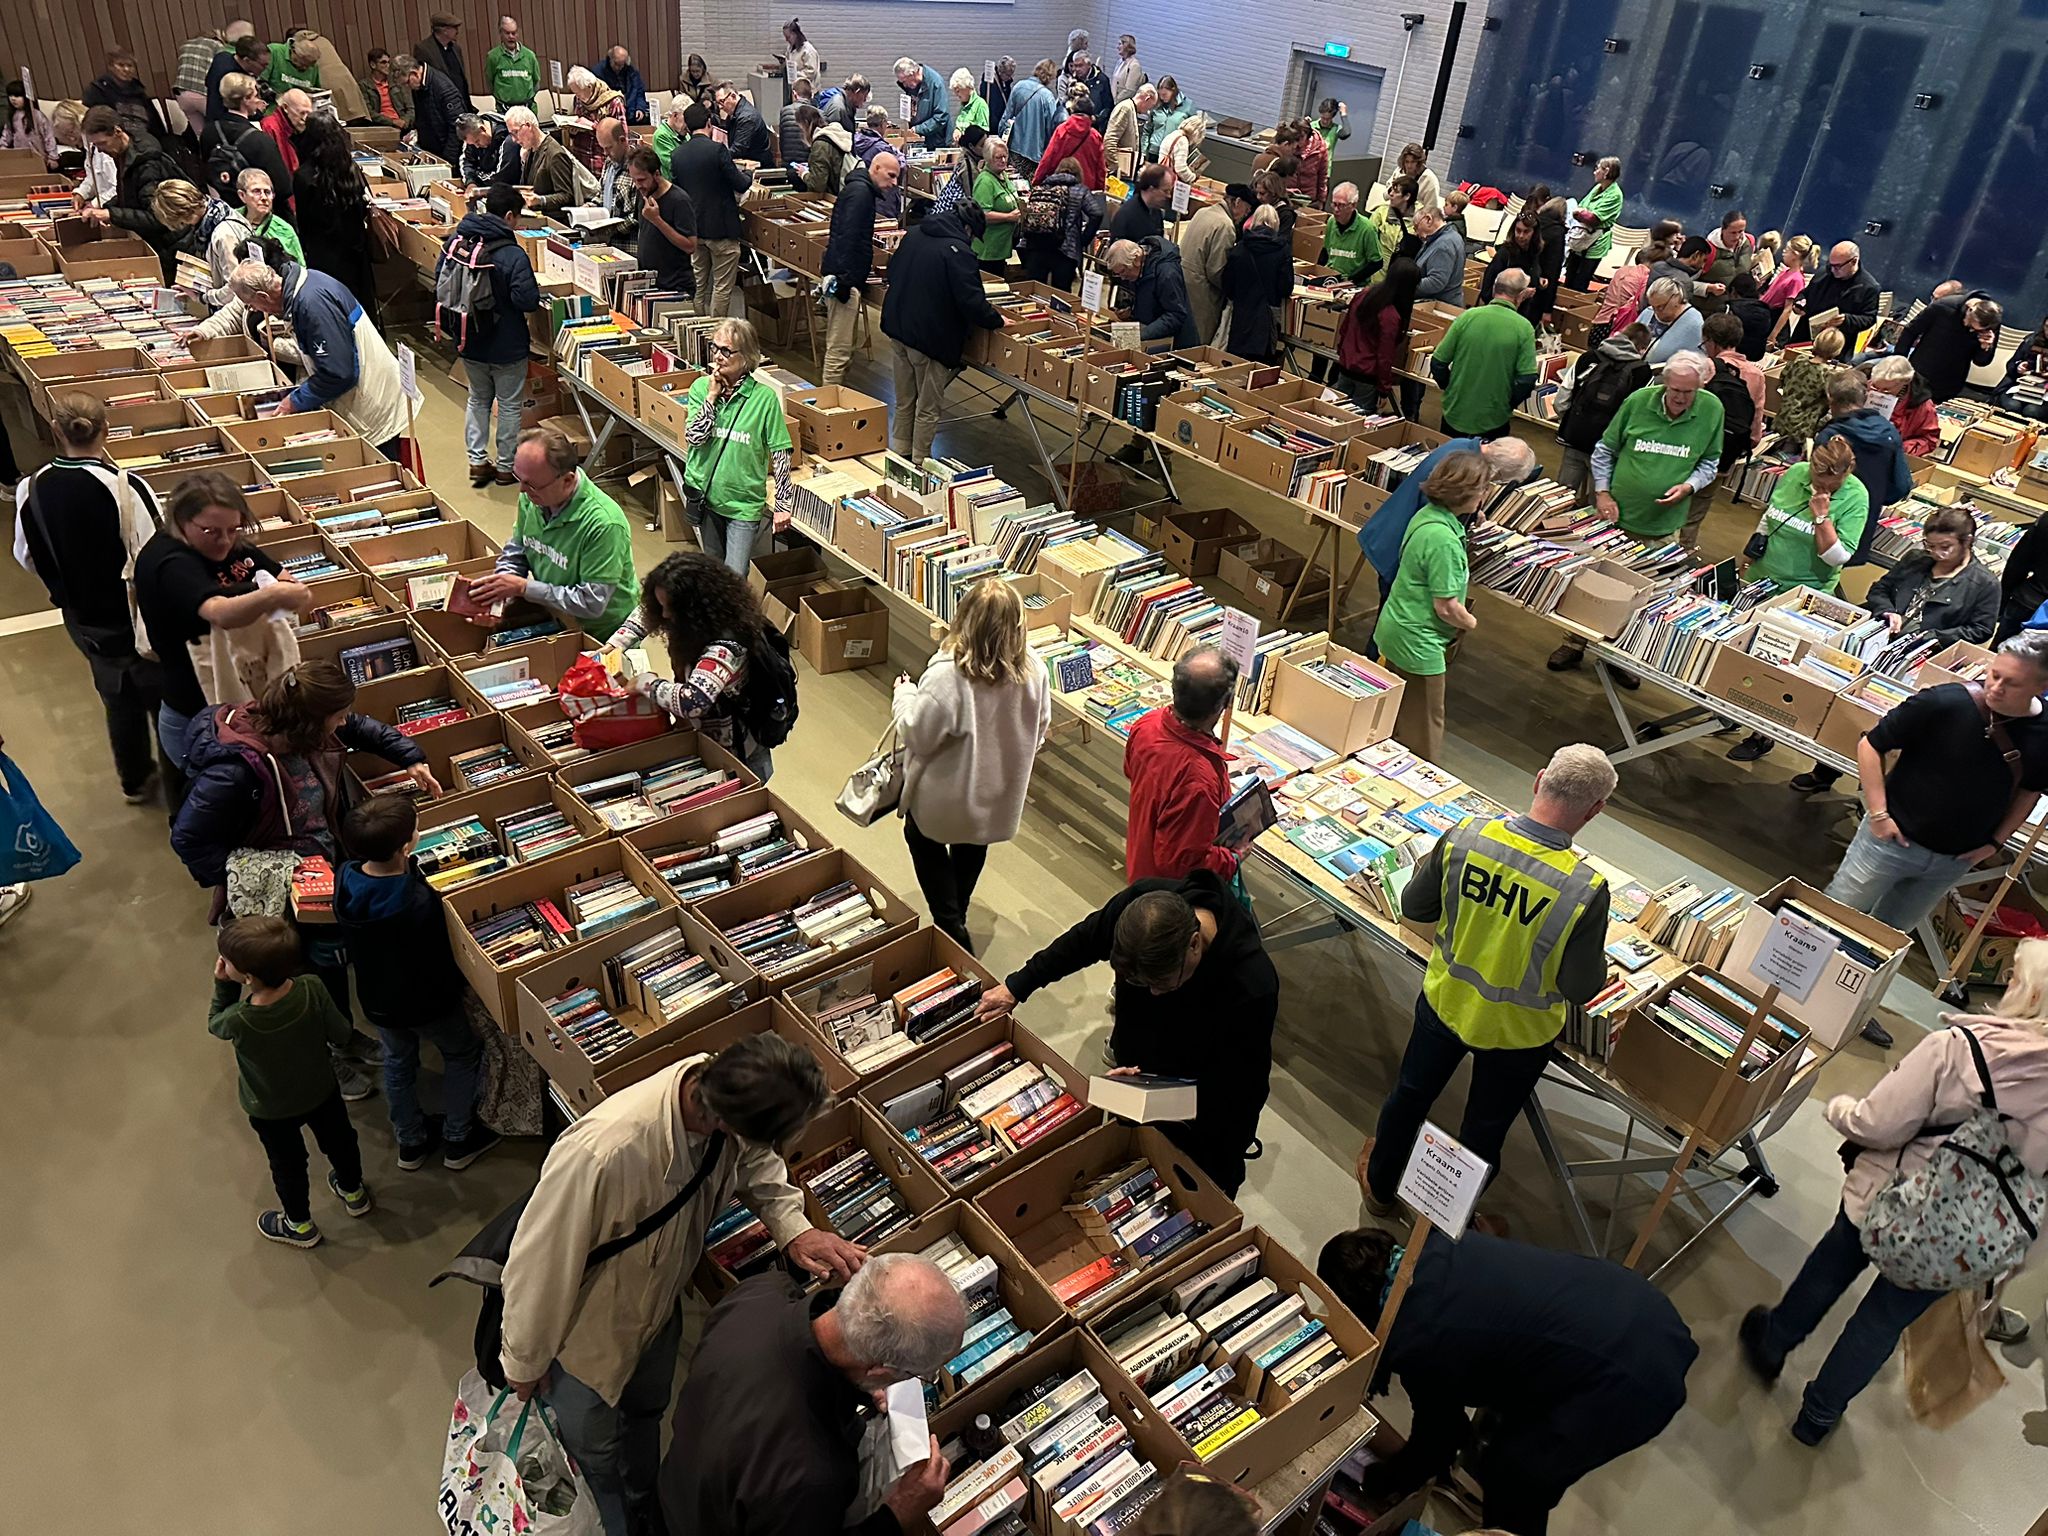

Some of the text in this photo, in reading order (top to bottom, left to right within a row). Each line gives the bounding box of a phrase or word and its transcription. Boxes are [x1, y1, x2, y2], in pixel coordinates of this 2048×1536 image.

[1634, 438, 1690, 458] Boekenmarkt
[1757, 636, 1793, 654] Gereedschap
[1763, 632, 1791, 647] Handboek
[391, 649, 402, 674] IRVIN
[1461, 863, 1552, 926] BHV
[1784, 930, 1817, 952] Kraam9
[1425, 1147, 1463, 1178] Kraam8
[1129, 1331, 1190, 1374] AQUITAINE PROGRESSION
[1021, 1402, 1046, 1422] GRAVE
[1024, 1406, 1053, 1429] RUNNING
[1045, 1399, 1102, 1443] MICHAEL CAINE
[1073, 1421, 1122, 1461] ROBERT LUDLUM
[1197, 1417, 1243, 1452] SLIPPING THE LINES
[1053, 1445, 1078, 1466] MOSAIC
[979, 1462, 1000, 1481] GAME
[1124, 1471, 1141, 1488] GOOD
[1138, 1463, 1152, 1477] THE
[1066, 1479, 1101, 1508] TOM WOLFE
[1111, 1483, 1126, 1498] LIAR
